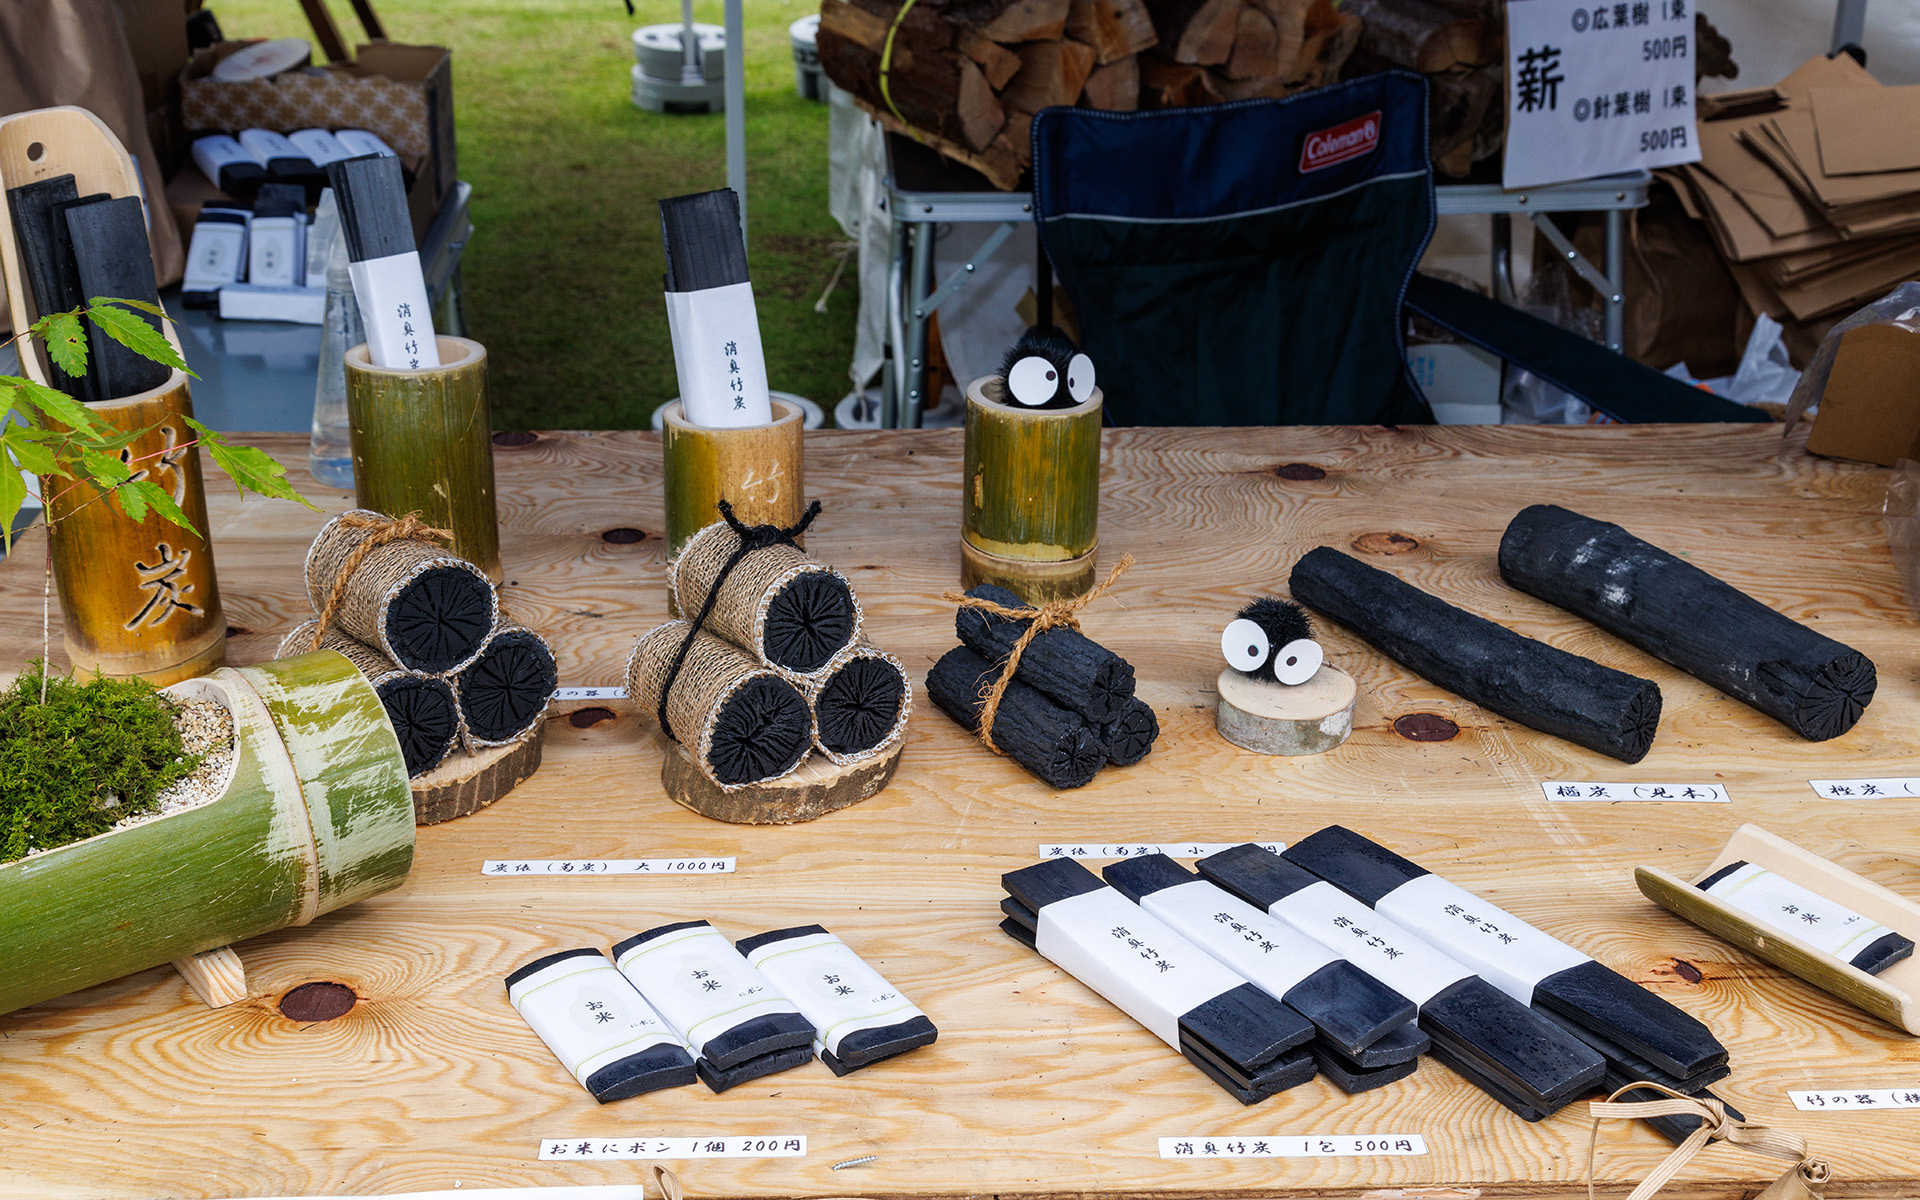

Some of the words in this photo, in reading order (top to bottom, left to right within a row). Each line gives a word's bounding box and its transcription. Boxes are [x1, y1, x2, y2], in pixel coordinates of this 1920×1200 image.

[1643, 35, 1688, 61] 500円
[1517, 44, 1565, 113] 薪
[1307, 127, 1364, 159] Coleman
[1640, 125, 1687, 152] 500円
[724, 341, 746, 411] 消臭竹炭
[1188, 846, 1204, 854] 小
[634, 862, 650, 871] 大
[666, 861, 725, 871] 1000円
[1444, 904, 1518, 945] 消臭竹炭
[1781, 904, 1821, 925] お米
[1213, 912, 1280, 954] 消臭竹炭
[1333, 916, 1404, 960] 消臭竹炭
[1111, 926, 1176, 974] 消臭竹炭
[690, 969, 723, 992] お米
[822, 974, 855, 996] お米
[585, 1001, 616, 1024] お米
[550, 1142, 670, 1155] お米にポン
[692, 1141, 726, 1153] 1個
[742, 1139, 802, 1151] 200円
[1174, 1141, 1272, 1155] 消臭竹炭
[1303, 1140, 1336, 1153] 1包
[1354, 1139, 1414, 1152] 500円
